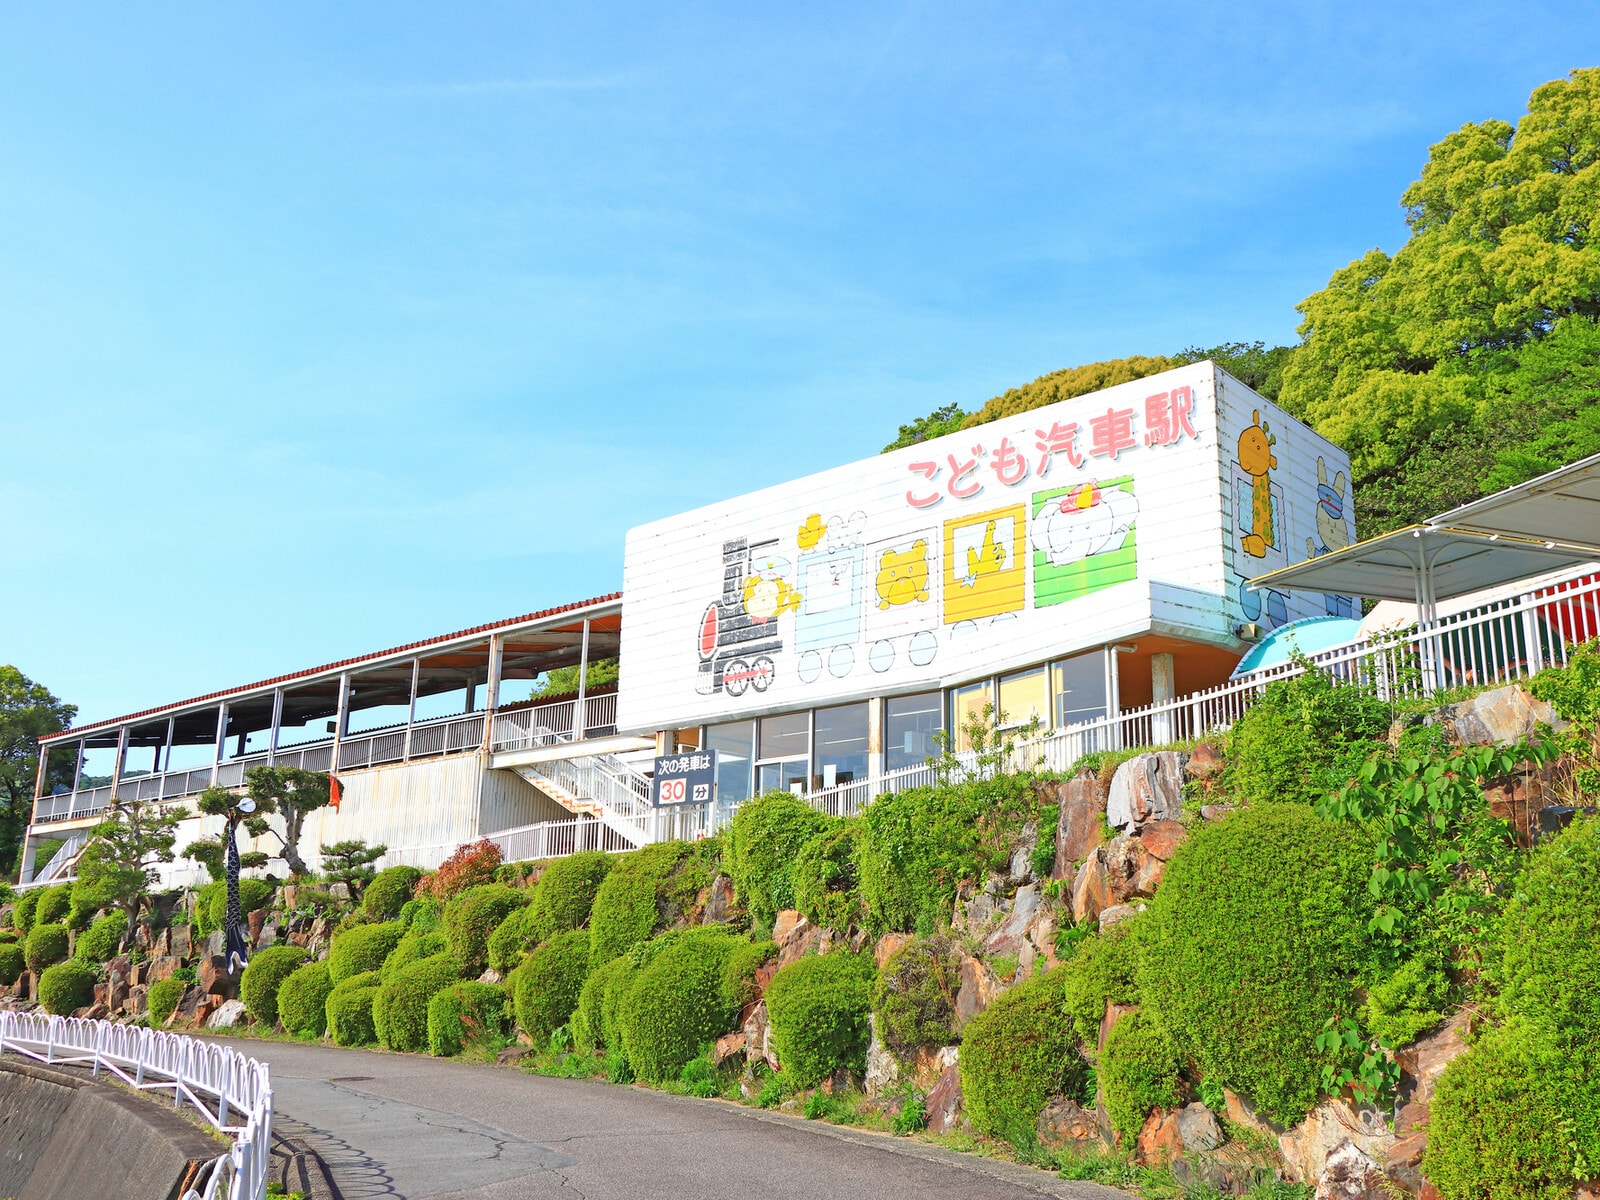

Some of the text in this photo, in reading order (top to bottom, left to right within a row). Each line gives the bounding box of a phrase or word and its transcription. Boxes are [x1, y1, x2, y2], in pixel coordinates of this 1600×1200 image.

[906, 386, 1198, 508] こども汽車駅
[658, 754, 710, 775] 次の発車は
[661, 781, 707, 800] 30 分
